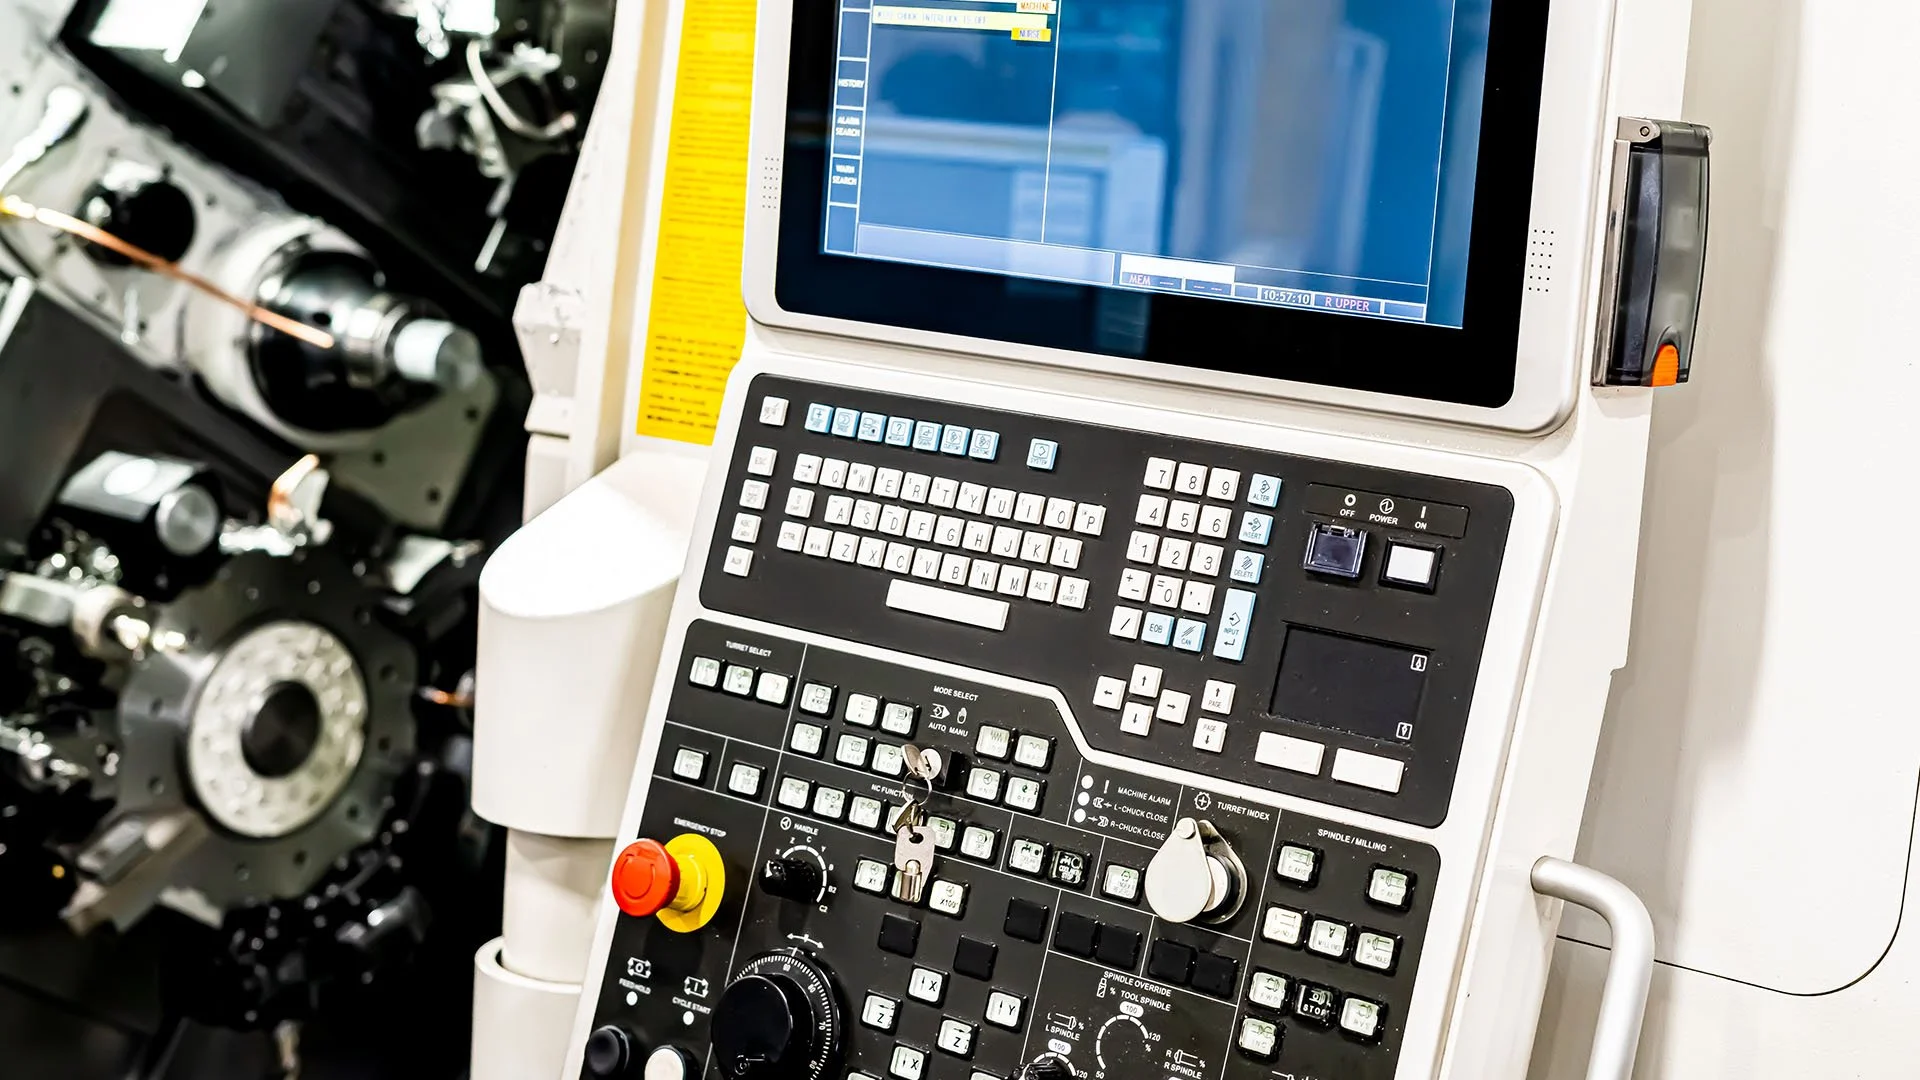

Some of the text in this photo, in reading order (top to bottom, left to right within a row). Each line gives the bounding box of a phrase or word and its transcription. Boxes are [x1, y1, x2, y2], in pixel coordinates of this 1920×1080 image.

[1019, 29, 1040, 39] NURSE
[838, 79, 865, 88] HISTORY
[837, 116, 860, 125] ALARM
[835, 126, 860, 137] SEARCH
[832, 175, 857, 186] SEARCH
[1128, 274, 1150, 286] MEM
[1262, 289, 1310, 305] 10:57:10
[1325, 296, 1370, 313] R UPPER
[831, 470, 840, 483] Q
[858, 475, 866, 487] W
[1159, 469, 1167, 484] 7
[1188, 475, 1198, 490] 8
[885, 479, 893, 493] E
[912, 484, 921, 497] R
[1221, 481, 1230, 496] 9
[942, 489, 950, 502] T
[970, 494, 978, 507] Y
[1252, 493, 1270, 502] ALTER
[998, 500, 1006, 513] U
[1026, 505, 1031, 518] I
[1339, 508, 1356, 518] OFF
[836, 508, 843, 520] A
[863, 512, 871, 525] S
[1057, 510, 1066, 525] O
[1149, 507, 1158, 522] 4
[1180, 513, 1189, 528] 5
[1369, 513, 1399, 525] POWER
[890, 517, 898, 531] D
[918, 522, 926, 535] F
[1087, 516, 1096, 530] P
[1212, 518, 1221, 533] 6
[1414, 521, 1428, 530] ON
[947, 529, 955, 542] G
[974, 533, 984, 547] H
[1242, 532, 1262, 540] INSERT
[841, 544, 850, 558] Z
[1004, 540, 1012, 553] J
[1032, 544, 1042, 558] K
[1142, 544, 1147, 558] 1
[868, 550, 877, 563] X
[897, 555, 905, 569] C
[1062, 549, 1070, 564] L
[1171, 550, 1181, 565] 2
[925, 561, 932, 574] V
[1203, 556, 1213, 571] 3
[951, 566, 960, 580] B
[980, 572, 990, 586] N
[1233, 568, 1254, 578] DELETE
[1010, 578, 1019, 592] M
[1034, 582, 1048, 591] ALT
[1164, 588, 1173, 603] 0
[1149, 623, 1163, 634] EOB
[1223, 628, 1240, 636] INPUT
[1181, 638, 1192, 646] CAN
[748, 646, 772, 657] SELECT
[933, 685, 979, 702] MODE SELECT
[1208, 700, 1222, 709] PAGE
[928, 722, 969, 738] AUTO MANU
[1202, 723, 1216, 733] PAGE
[871, 783, 881, 793] NC
[1117, 786, 1172, 806] MACHINE ALARM
[1113, 804, 1169, 824] L-CHUCK CLOSE
[1216, 801, 1271, 821] TURRET INDEX
[673, 817, 727, 838] EMERGENCY STOP
[793, 823, 819, 836] HANDLE
[1109, 821, 1166, 841] R-CHUCK CLOSE
[789, 837, 796, 845] Z
[806, 835, 813, 843] C
[1317, 828, 1351, 844] SPINDLE
[1355, 838, 1387, 852] MILLING
[819, 904, 828, 913] C2
[619, 977, 651, 995] FEED HOLD
[928, 980, 938, 992] X
[1103, 970, 1172, 997] SPINDLE OVERRIDE
[672, 996, 712, 1015] CYCLE START
[1120, 990, 1140, 1003] TOOL
[1140, 996, 1172, 1012] SPINDLE
[1008, 1005, 1016, 1016] Y
[1125, 1004, 1138, 1014] 100
[876, 1012, 885, 1024] Z
[818, 1021, 826, 1031] 70
[1045, 1024, 1081, 1041] L SPINDLE
[953, 1036, 962, 1048] Z
[1149, 1032, 1161, 1041] 120
[1053, 1042, 1066, 1052] 100
[1165, 1050, 1172, 1058] R
[809, 1060, 818, 1070] 60
[910, 1058, 919, 1070] X
[1163, 1061, 1203, 1080] R SPINDLE
[1076, 1069, 1088, 1079] 120
[1095, 1070, 1105, 1080] 50
